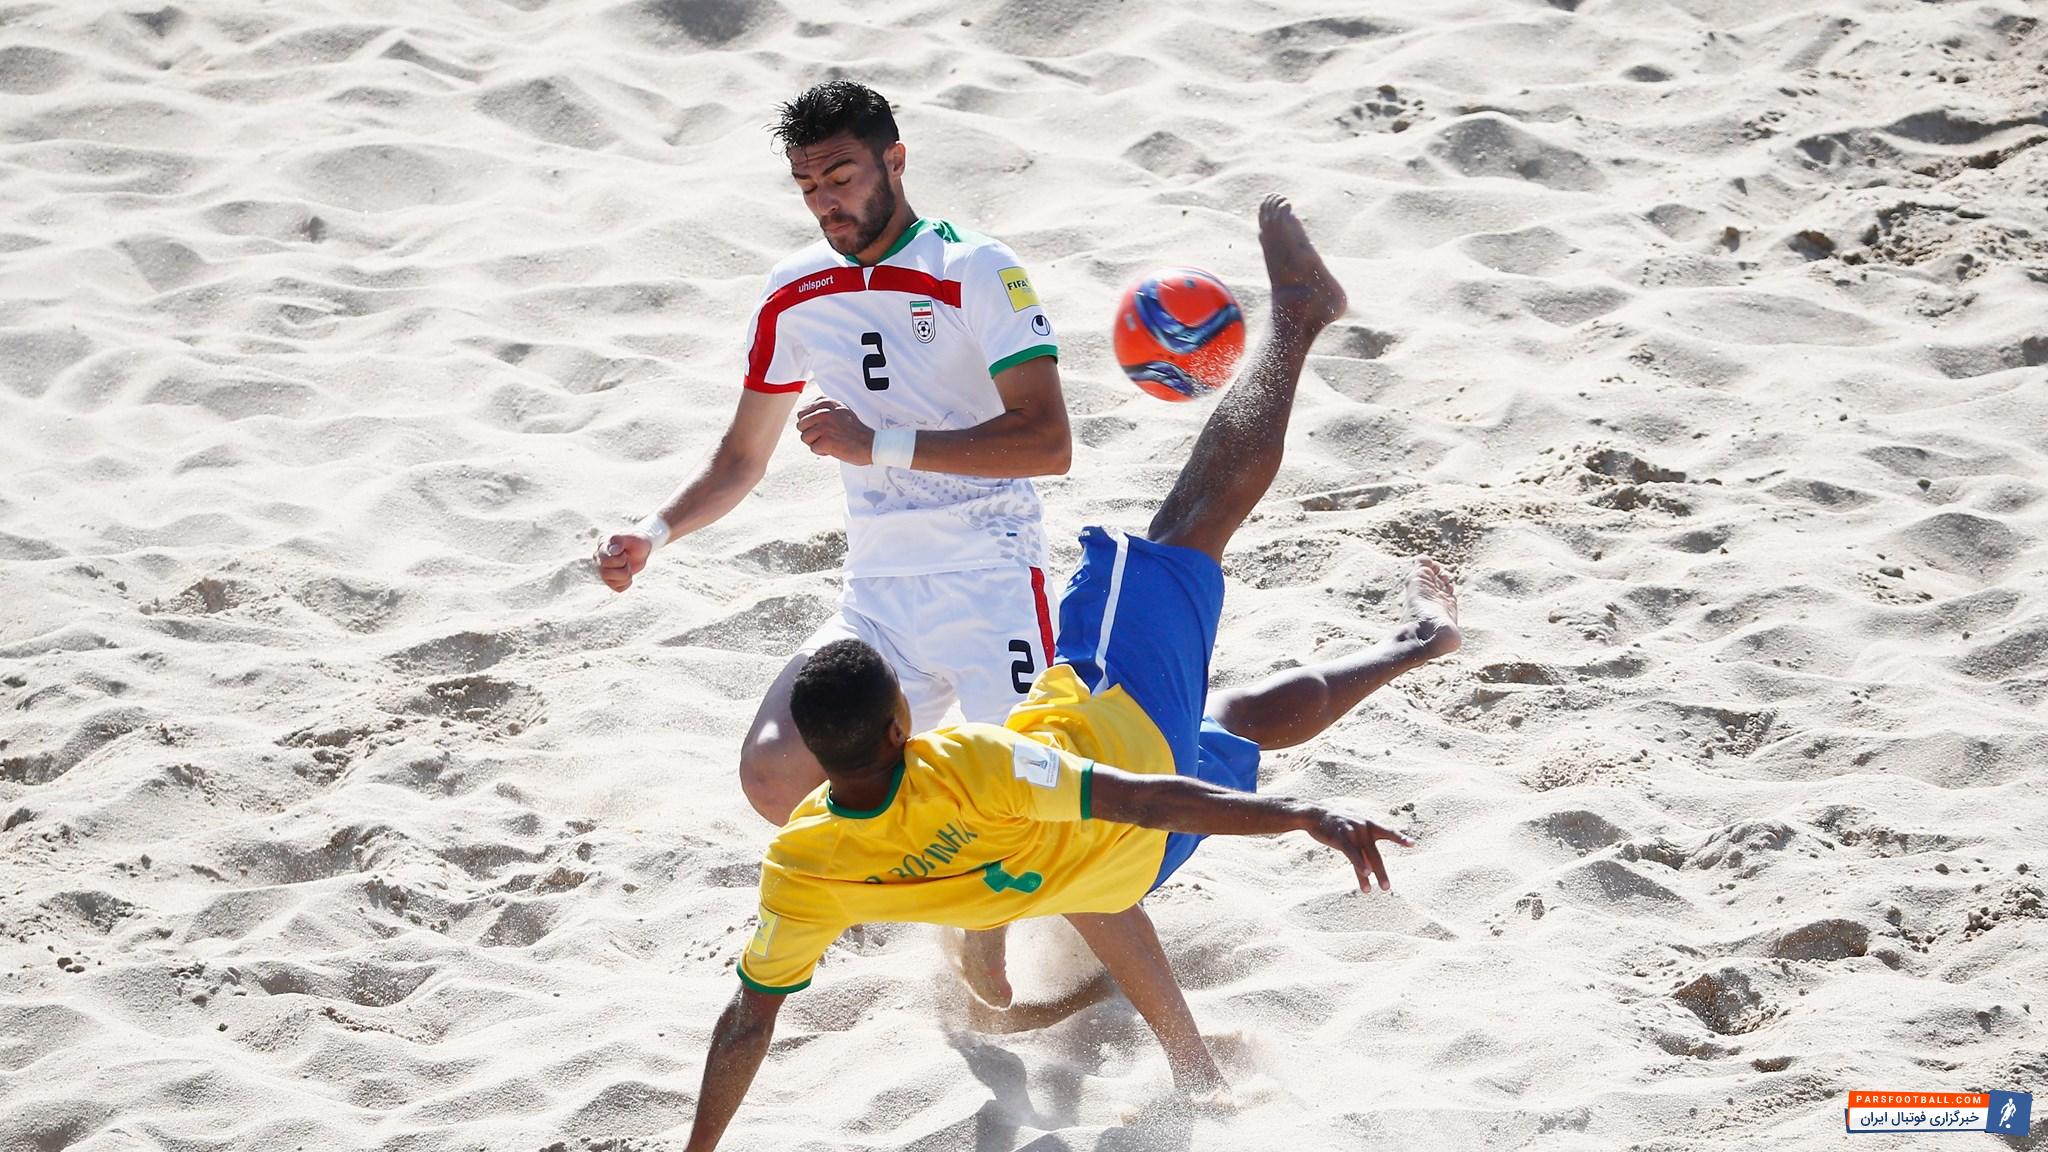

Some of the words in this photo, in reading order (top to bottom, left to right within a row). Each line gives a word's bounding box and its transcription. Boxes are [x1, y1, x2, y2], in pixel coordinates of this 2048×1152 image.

[798, 275, 834, 293] uhlsport
[1007, 279, 1029, 291] FIFA
[861, 332, 890, 391] 2
[1008, 639, 1035, 694] 2
